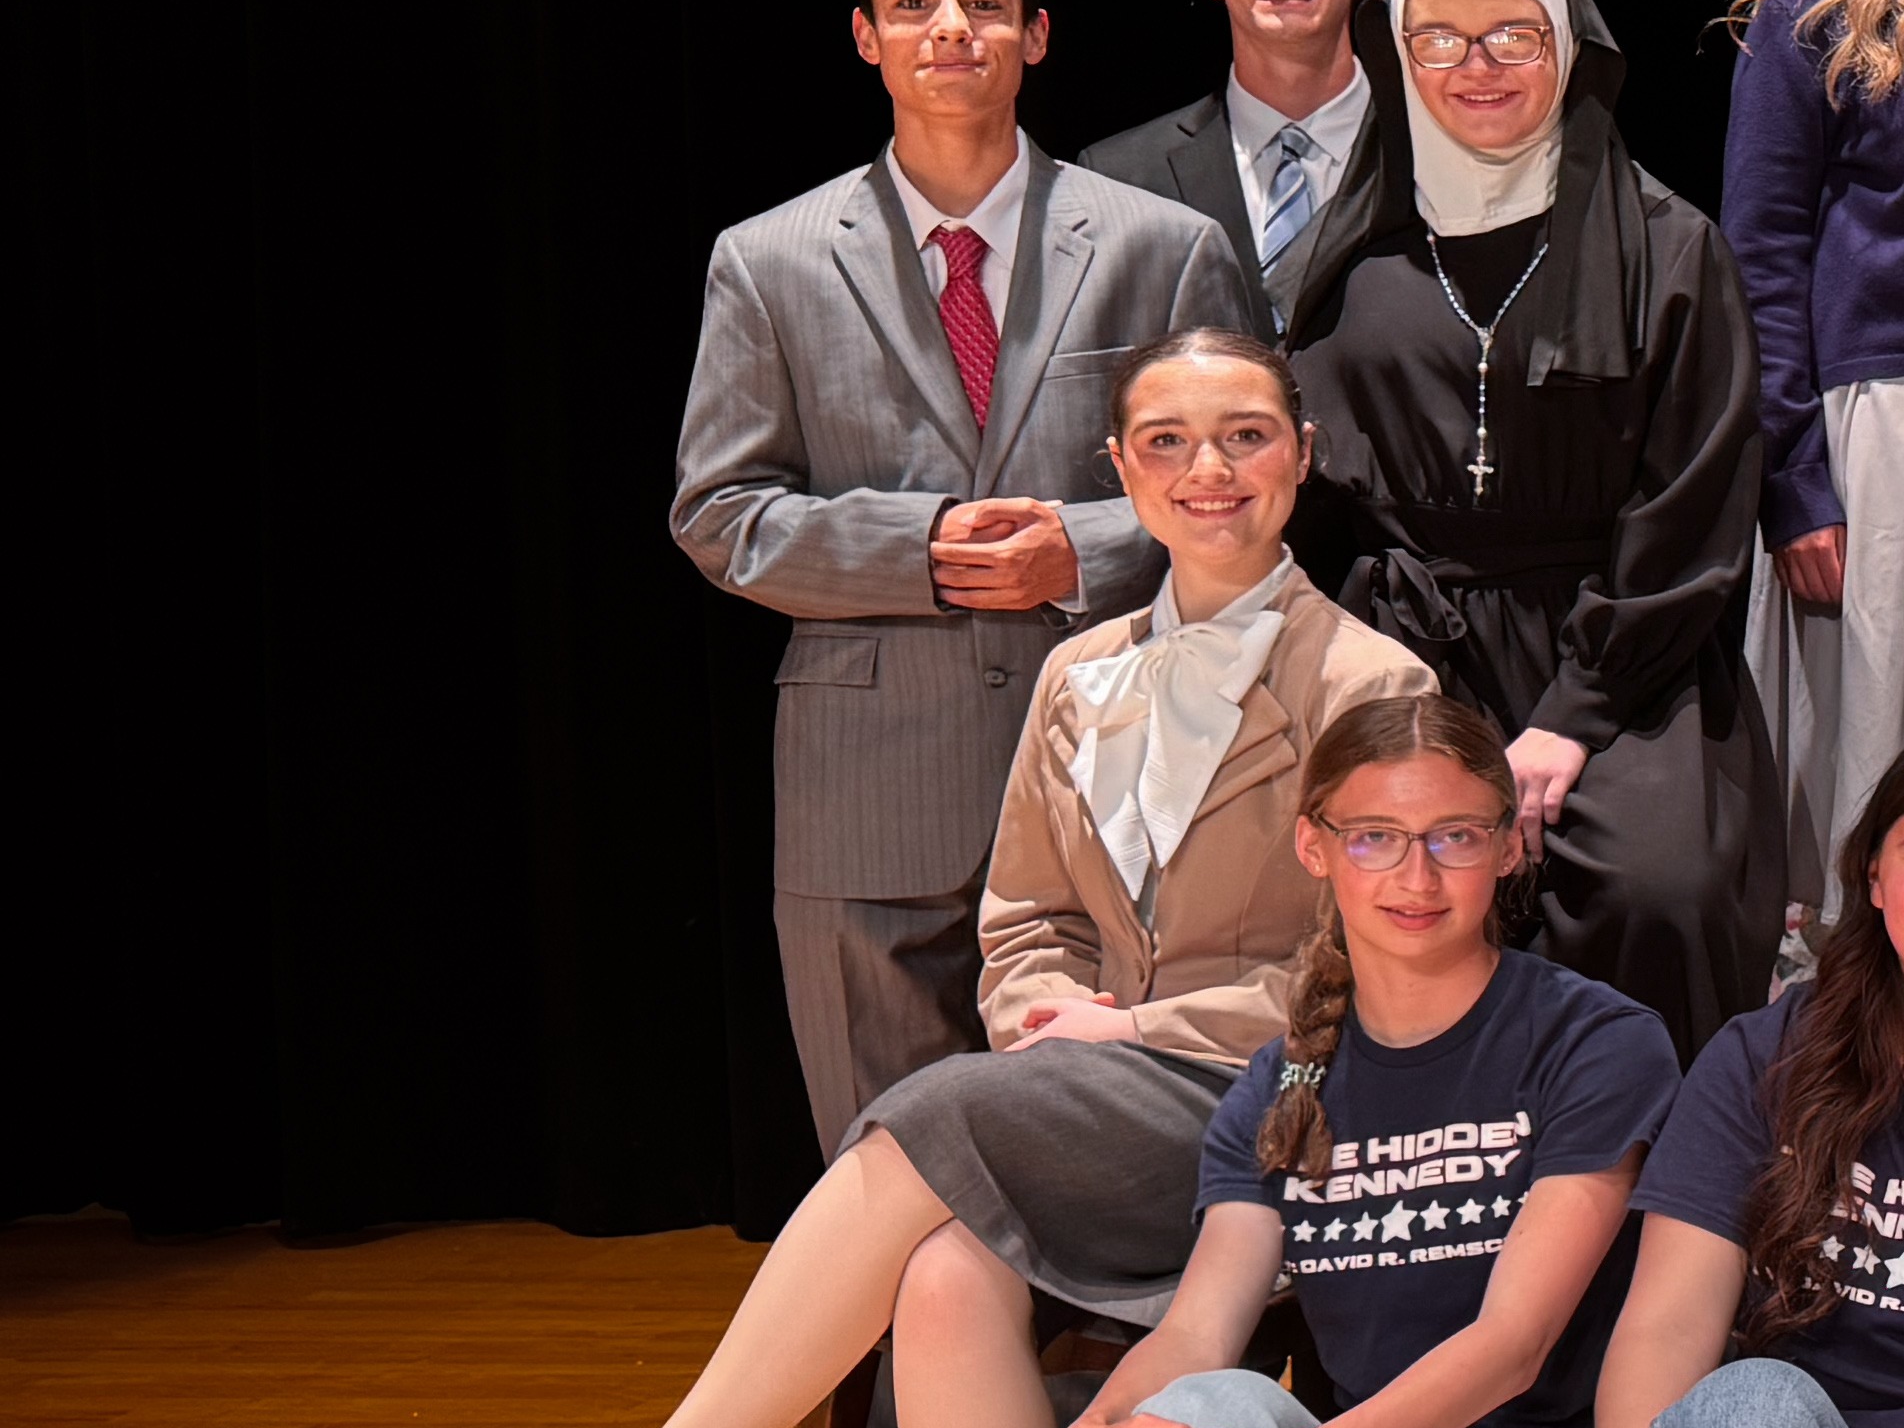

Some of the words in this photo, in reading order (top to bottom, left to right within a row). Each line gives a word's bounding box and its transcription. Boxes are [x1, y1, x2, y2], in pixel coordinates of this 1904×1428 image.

[1283, 1149, 1522, 1204] KENNEDY
[1300, 1253, 1374, 1274] DAVID
[1378, 1252, 1406, 1267] R.
[1410, 1238, 1506, 1264] REMSC
